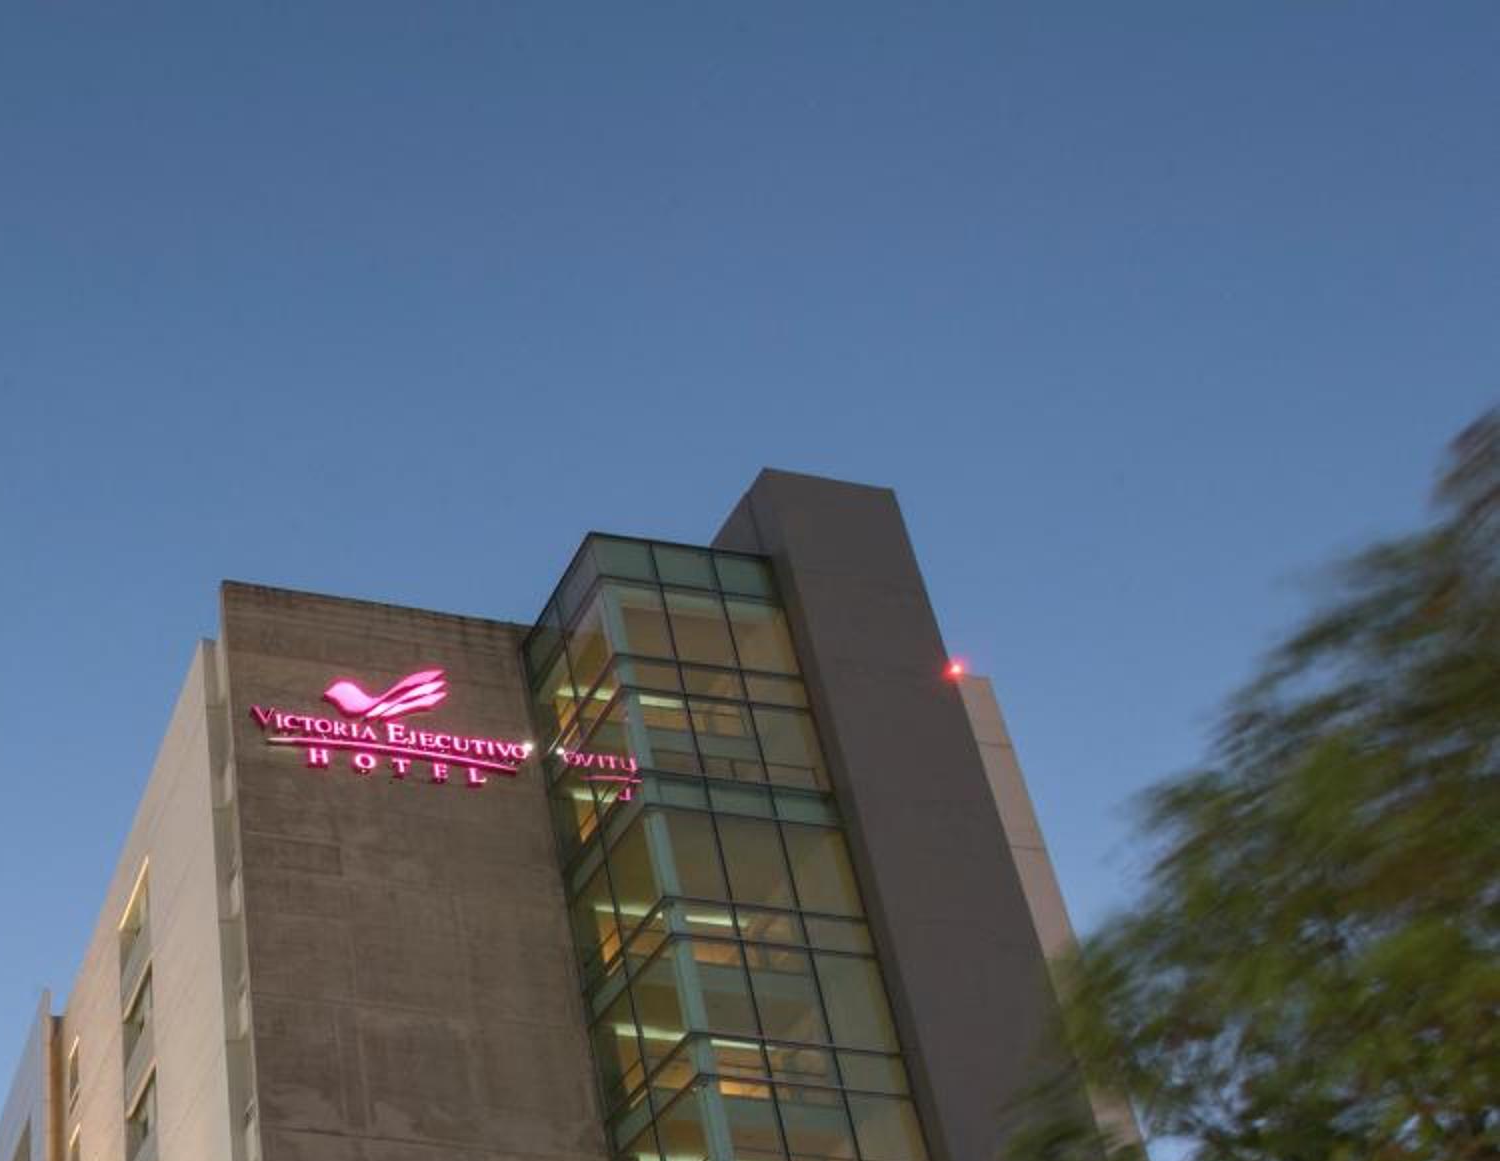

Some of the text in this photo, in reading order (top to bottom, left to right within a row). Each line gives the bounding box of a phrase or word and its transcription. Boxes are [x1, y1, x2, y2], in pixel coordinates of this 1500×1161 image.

[251, 704, 533, 760] VICTORIA EJECUTIVO
[308, 746, 488, 784] HOTEL
